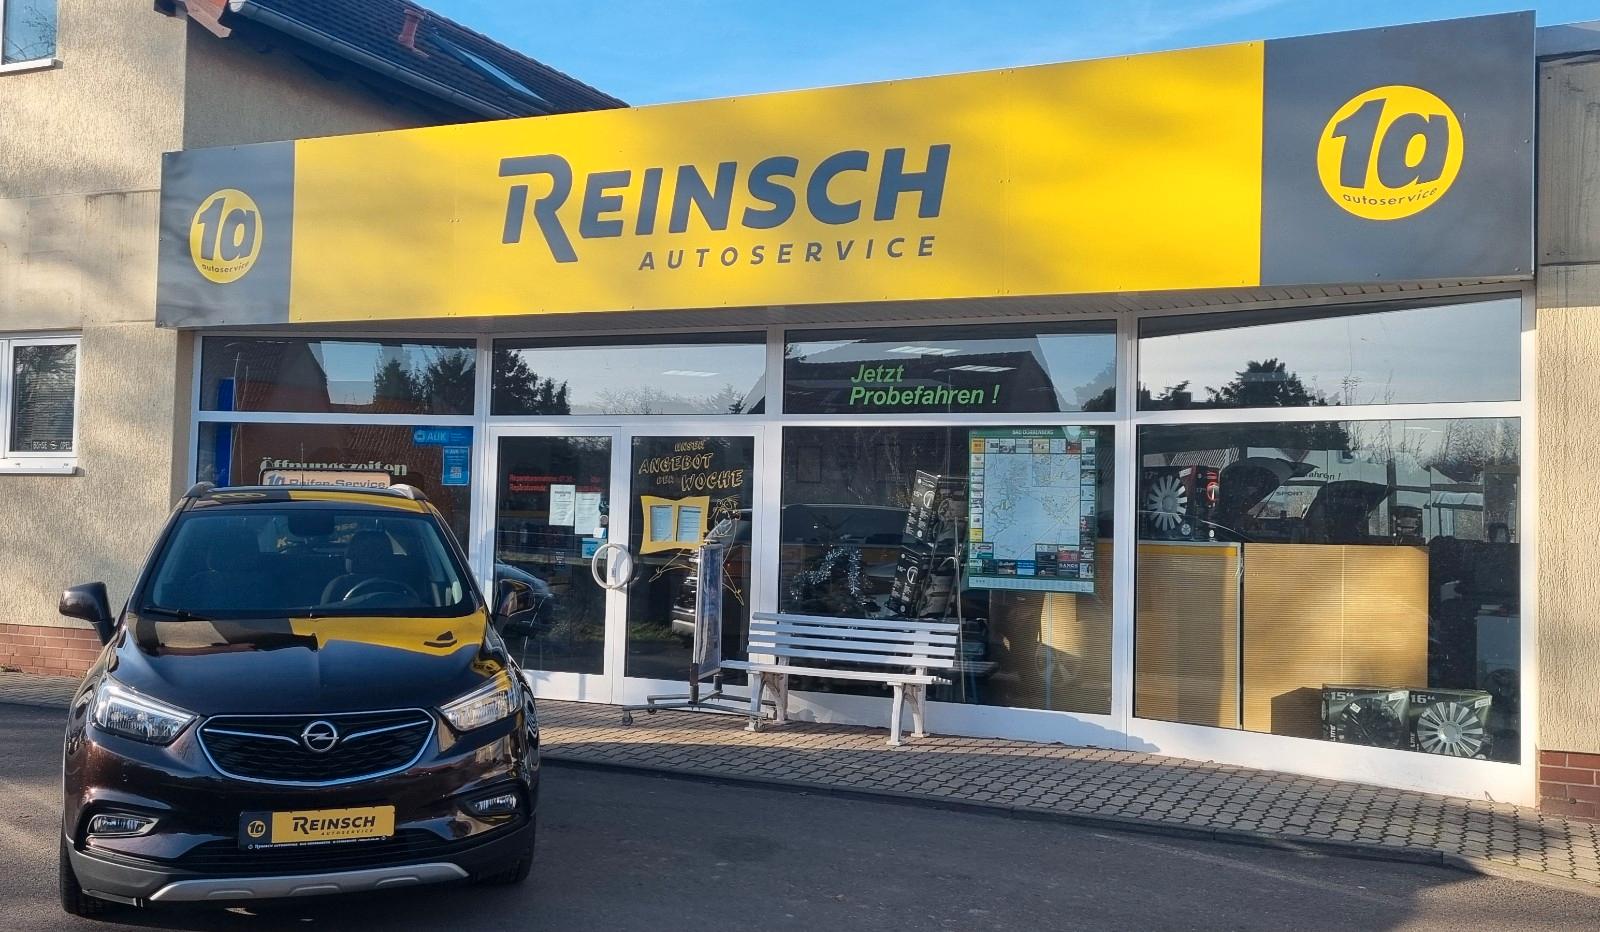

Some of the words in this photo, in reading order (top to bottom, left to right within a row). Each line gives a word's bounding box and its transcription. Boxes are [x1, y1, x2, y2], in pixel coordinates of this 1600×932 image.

[1331, 98, 1450, 189] 1a
[498, 143, 951, 263] REINSCH
[1342, 187, 1438, 206] autoservice
[197, 197, 257, 262] 1a
[638, 235, 936, 271] AUTOSERVICE
[201, 261, 250, 273] autoservice
[850, 364, 905, 384] Jetzt
[849, 385, 985, 406] Probefahren
[991, 384, 1001, 404] !
[674, 440, 705, 452] UNSER
[638, 453, 714, 475] ANGEBOT
[681, 469, 744, 492] WOCHE
[292, 816, 376, 834] REINSCH
